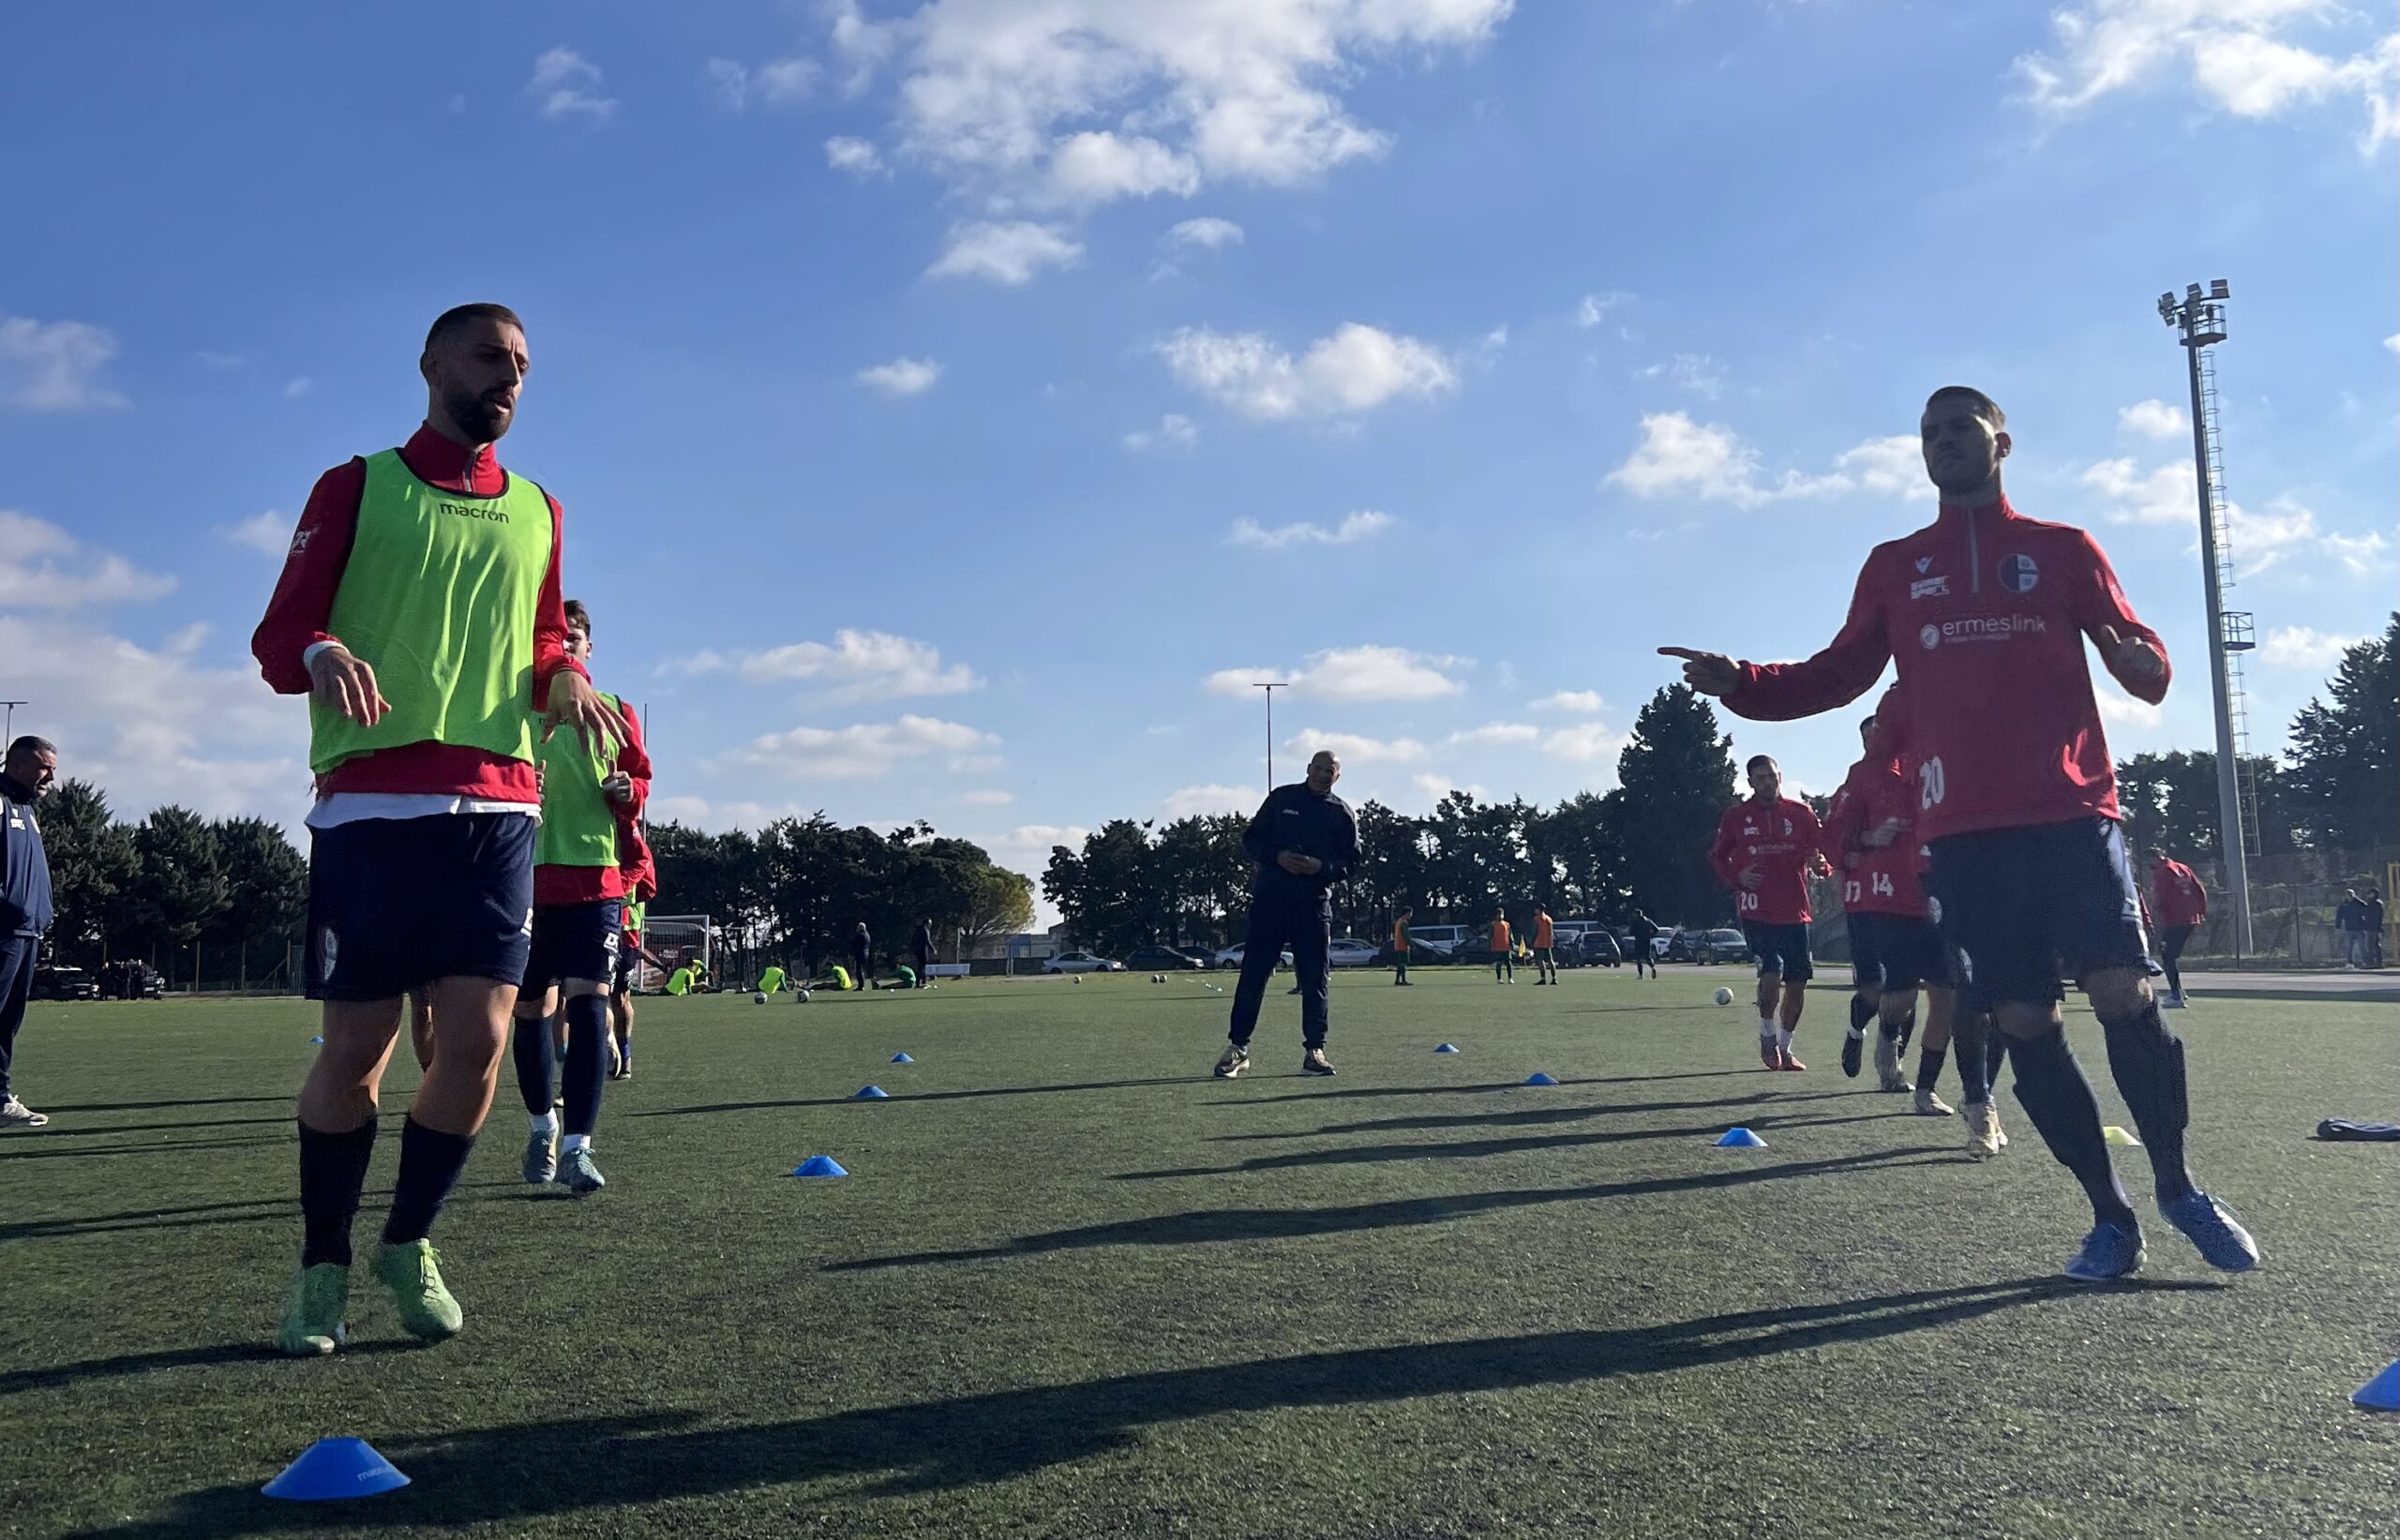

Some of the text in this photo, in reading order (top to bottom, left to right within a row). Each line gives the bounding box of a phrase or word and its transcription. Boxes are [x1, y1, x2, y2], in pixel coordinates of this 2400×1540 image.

[439, 502, 510, 524] macron
[1942, 613, 2047, 635] ermeslink
[1919, 755, 1945, 811] 20
[1872, 872, 1894, 897] 14
[1740, 891, 1759, 910] 20
